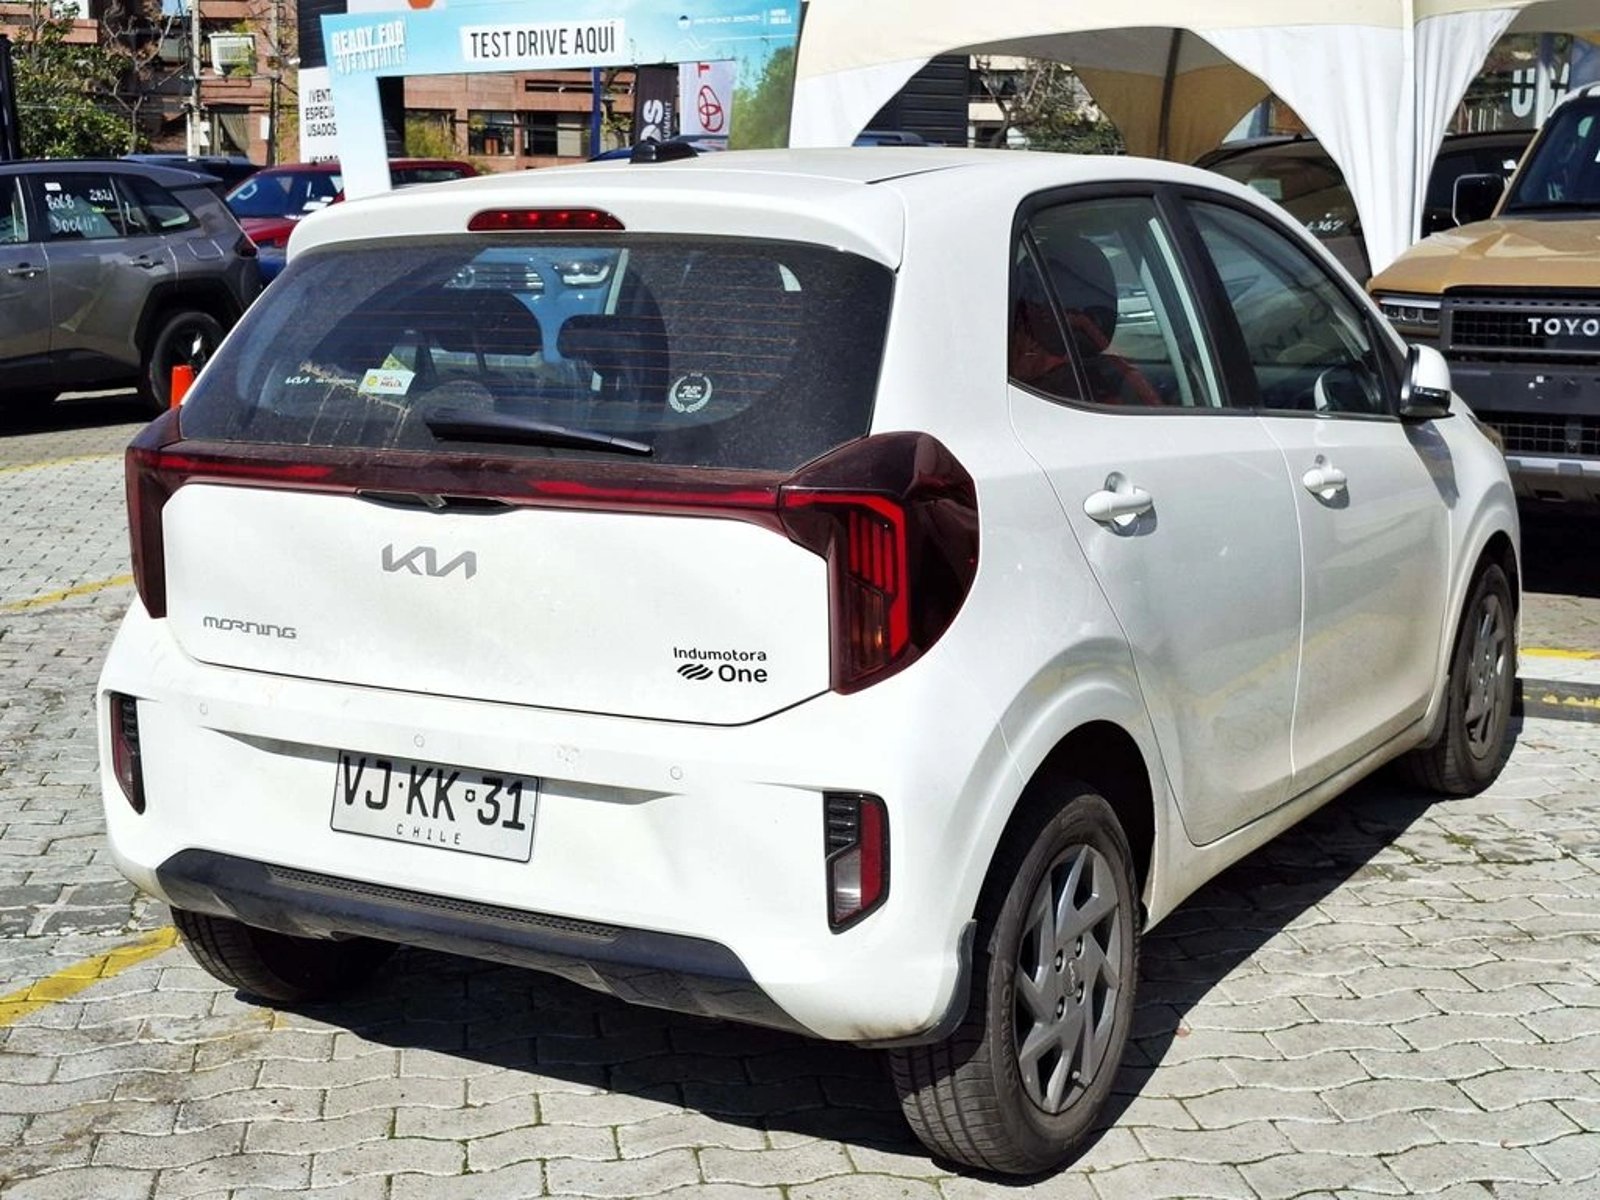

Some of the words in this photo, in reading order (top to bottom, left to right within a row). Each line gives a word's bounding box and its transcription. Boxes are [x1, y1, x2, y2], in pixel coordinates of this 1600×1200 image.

[470, 32, 511, 58] TEST
[517, 28, 568, 56] DRIVE
[574, 20, 615, 55] AQUÍ
[307, 122, 337, 137] USADOS
[1527, 317, 1599, 337] TOYO
[381, 543, 478, 580] KIA
[203, 615, 297, 639] MORNING
[673, 646, 767, 661] Indumotora
[718, 663, 768, 683] One
[396, 822, 461, 846] CHILE
